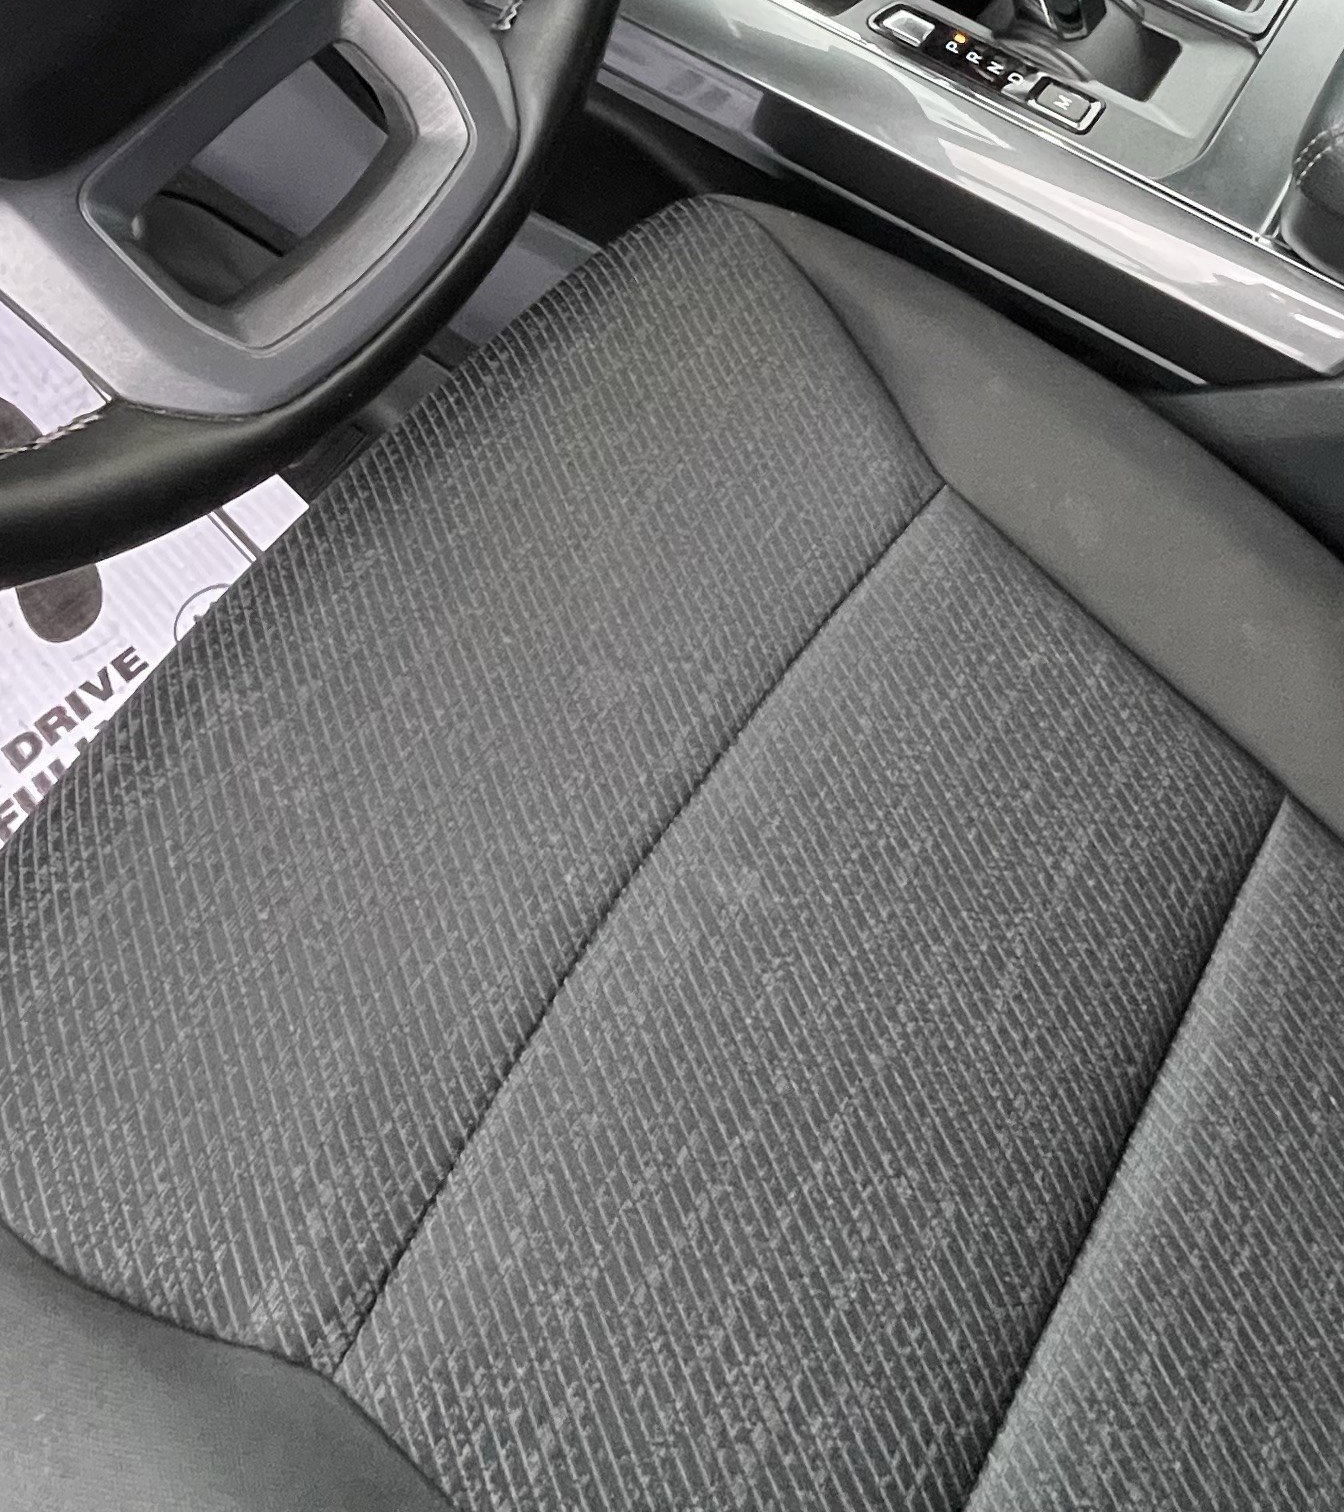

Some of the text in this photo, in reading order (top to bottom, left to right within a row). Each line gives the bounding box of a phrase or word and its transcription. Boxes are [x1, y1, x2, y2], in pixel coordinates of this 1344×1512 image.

[945, 40, 1024, 86] P R N D
[1053, 94, 1073, 111] M
[1, 645, 150, 774] DRIVE
